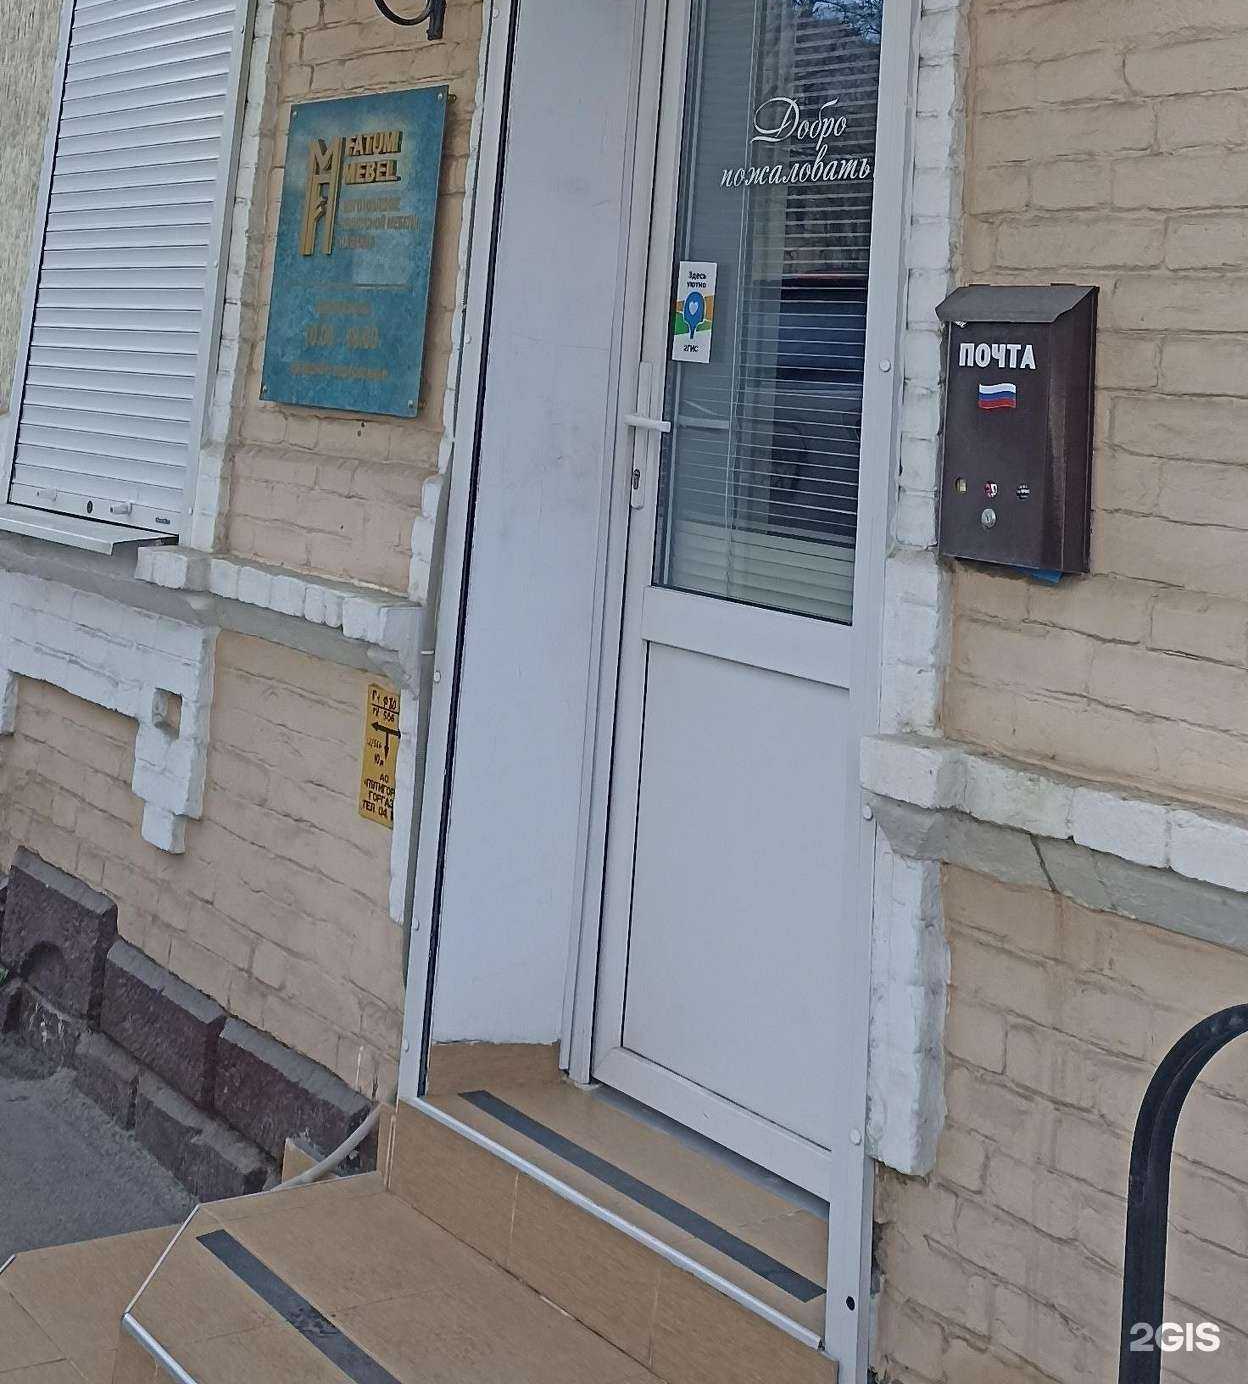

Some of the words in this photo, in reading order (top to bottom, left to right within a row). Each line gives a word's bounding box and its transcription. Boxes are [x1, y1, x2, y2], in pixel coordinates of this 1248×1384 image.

[750, 96, 848, 151] Добро
[687, 281, 707, 289] уютно
[688, 270, 707, 281] Здесь
[958, 342, 1036, 370] ПОЧТА
